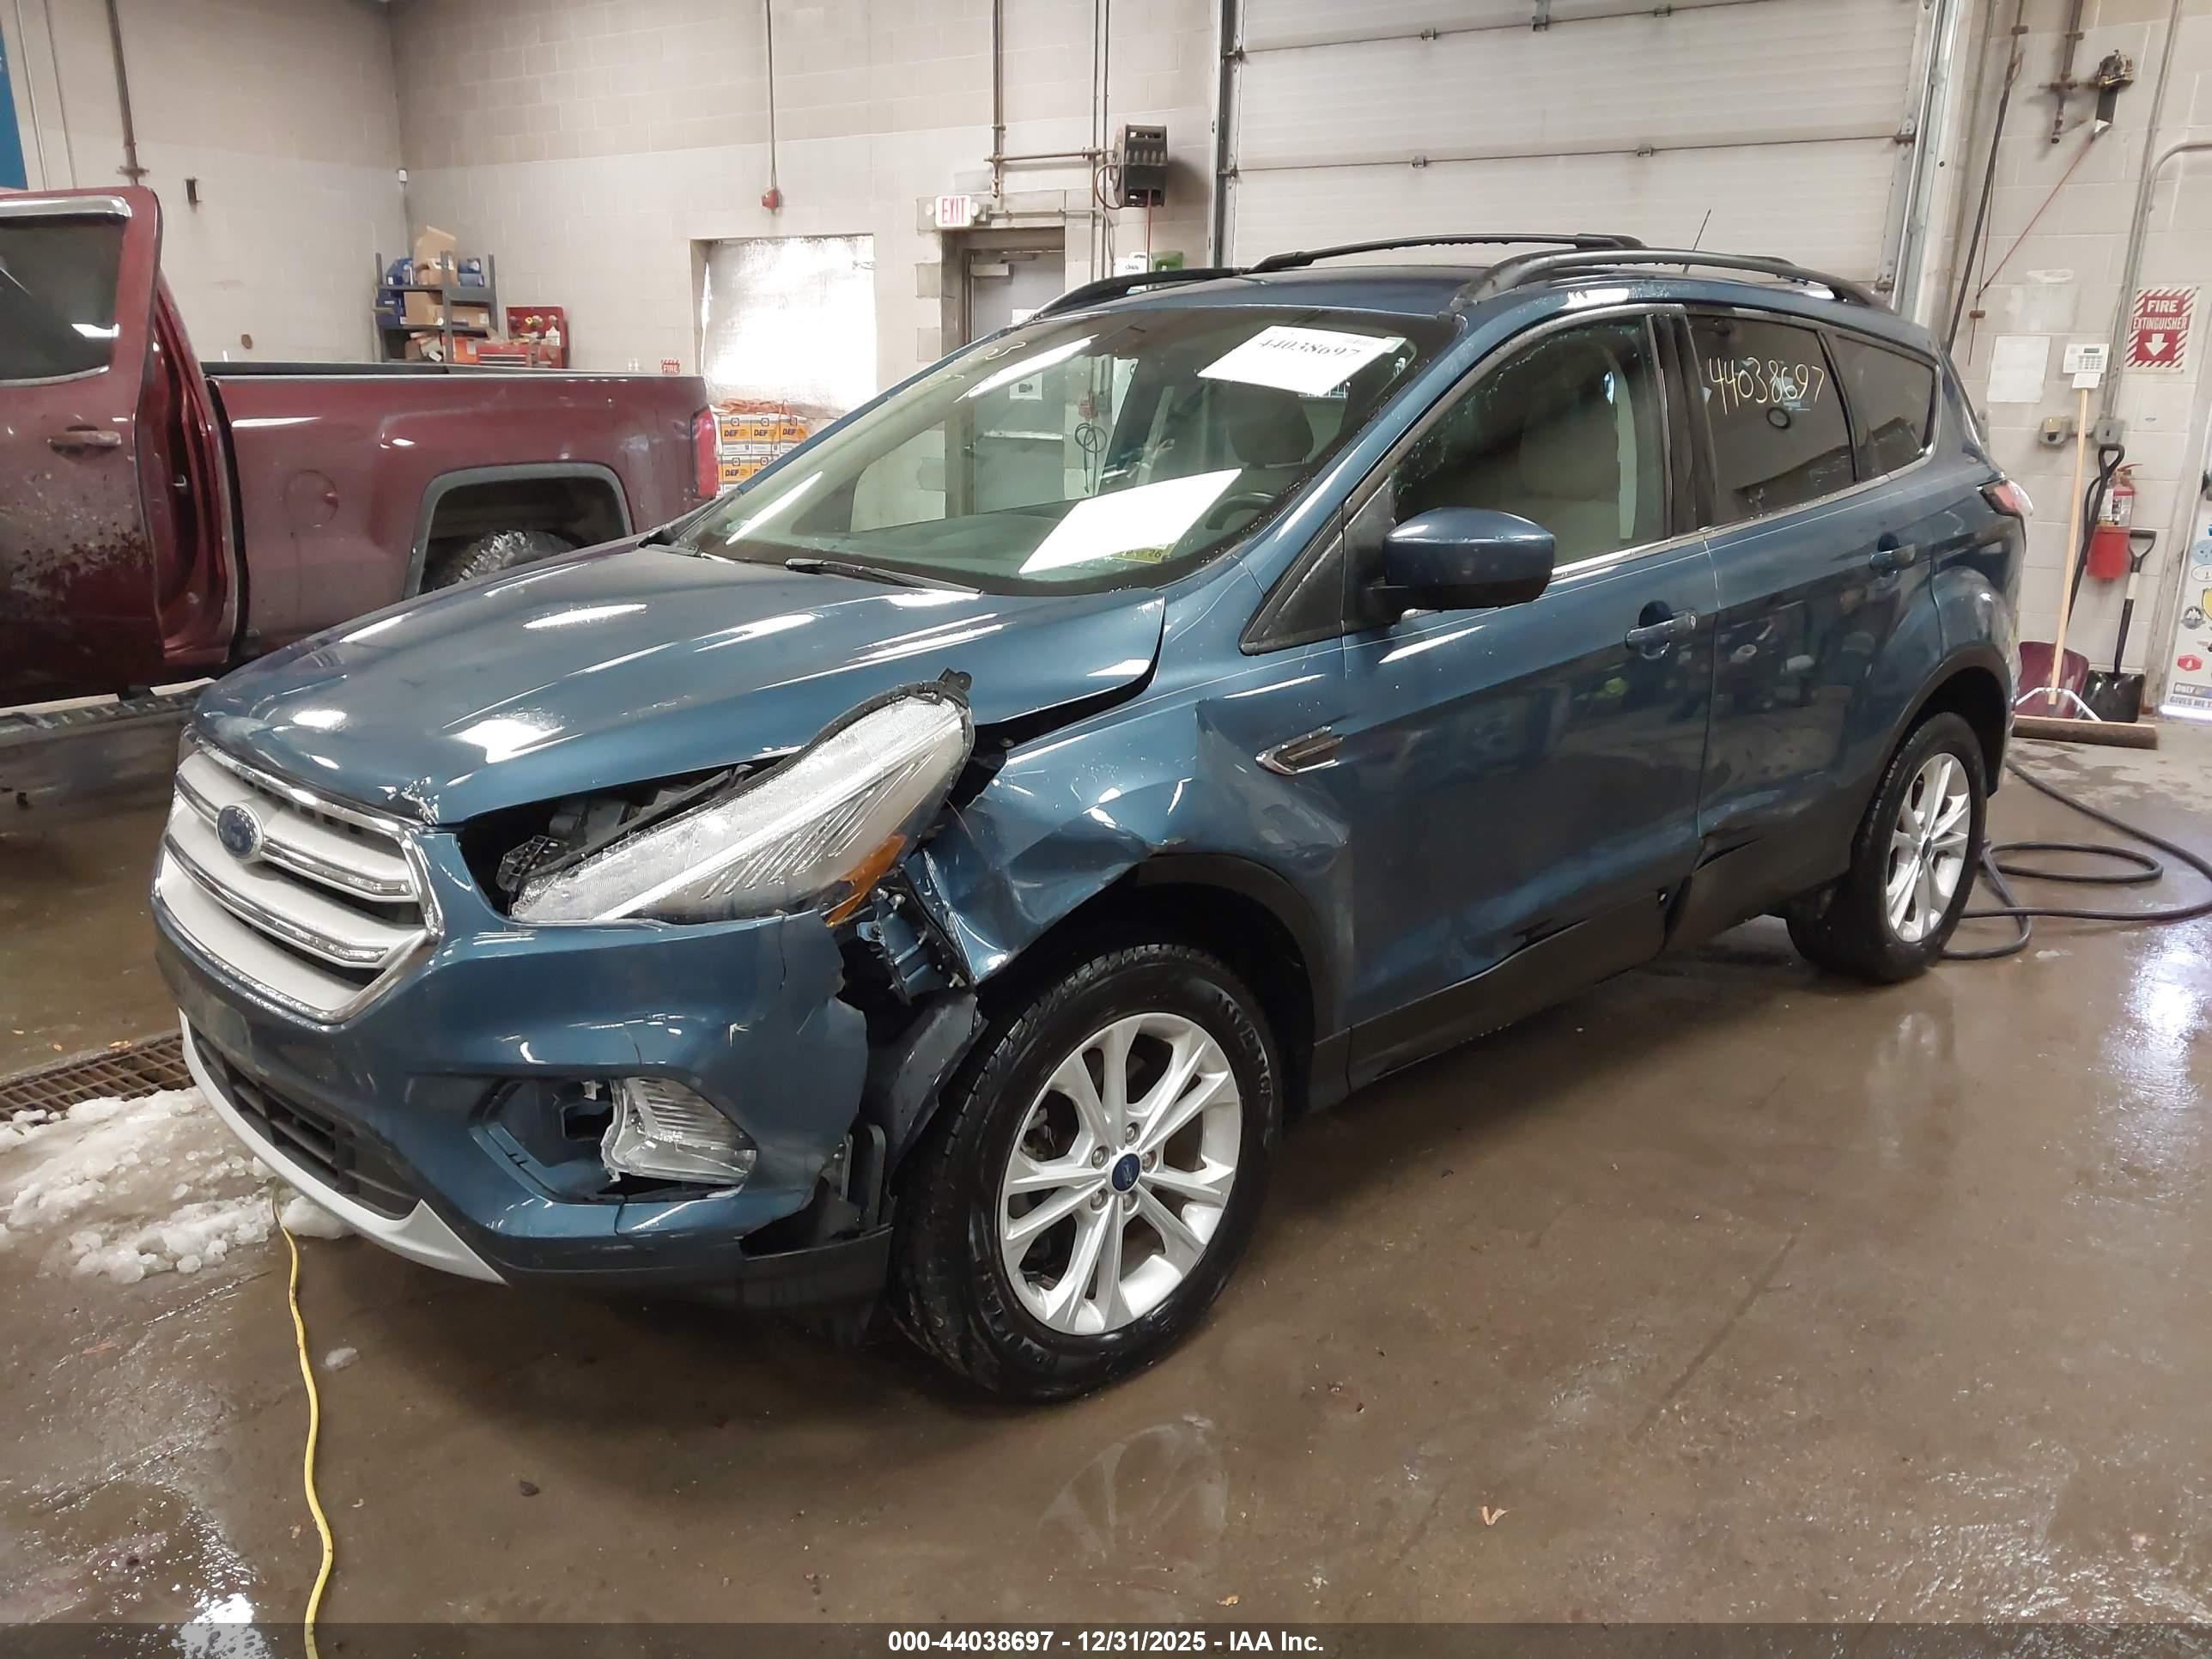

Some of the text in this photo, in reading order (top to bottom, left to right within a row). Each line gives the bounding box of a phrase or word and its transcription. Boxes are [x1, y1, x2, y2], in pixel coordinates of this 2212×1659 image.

[942, 198, 966, 223] EXIT
[2147, 299, 2179, 313] FIRE
[2132, 316, 2189, 331] EXTINGUISHER
[1258, 337, 1361, 359] 44038697
[1708, 356, 1826, 416] 44038697
